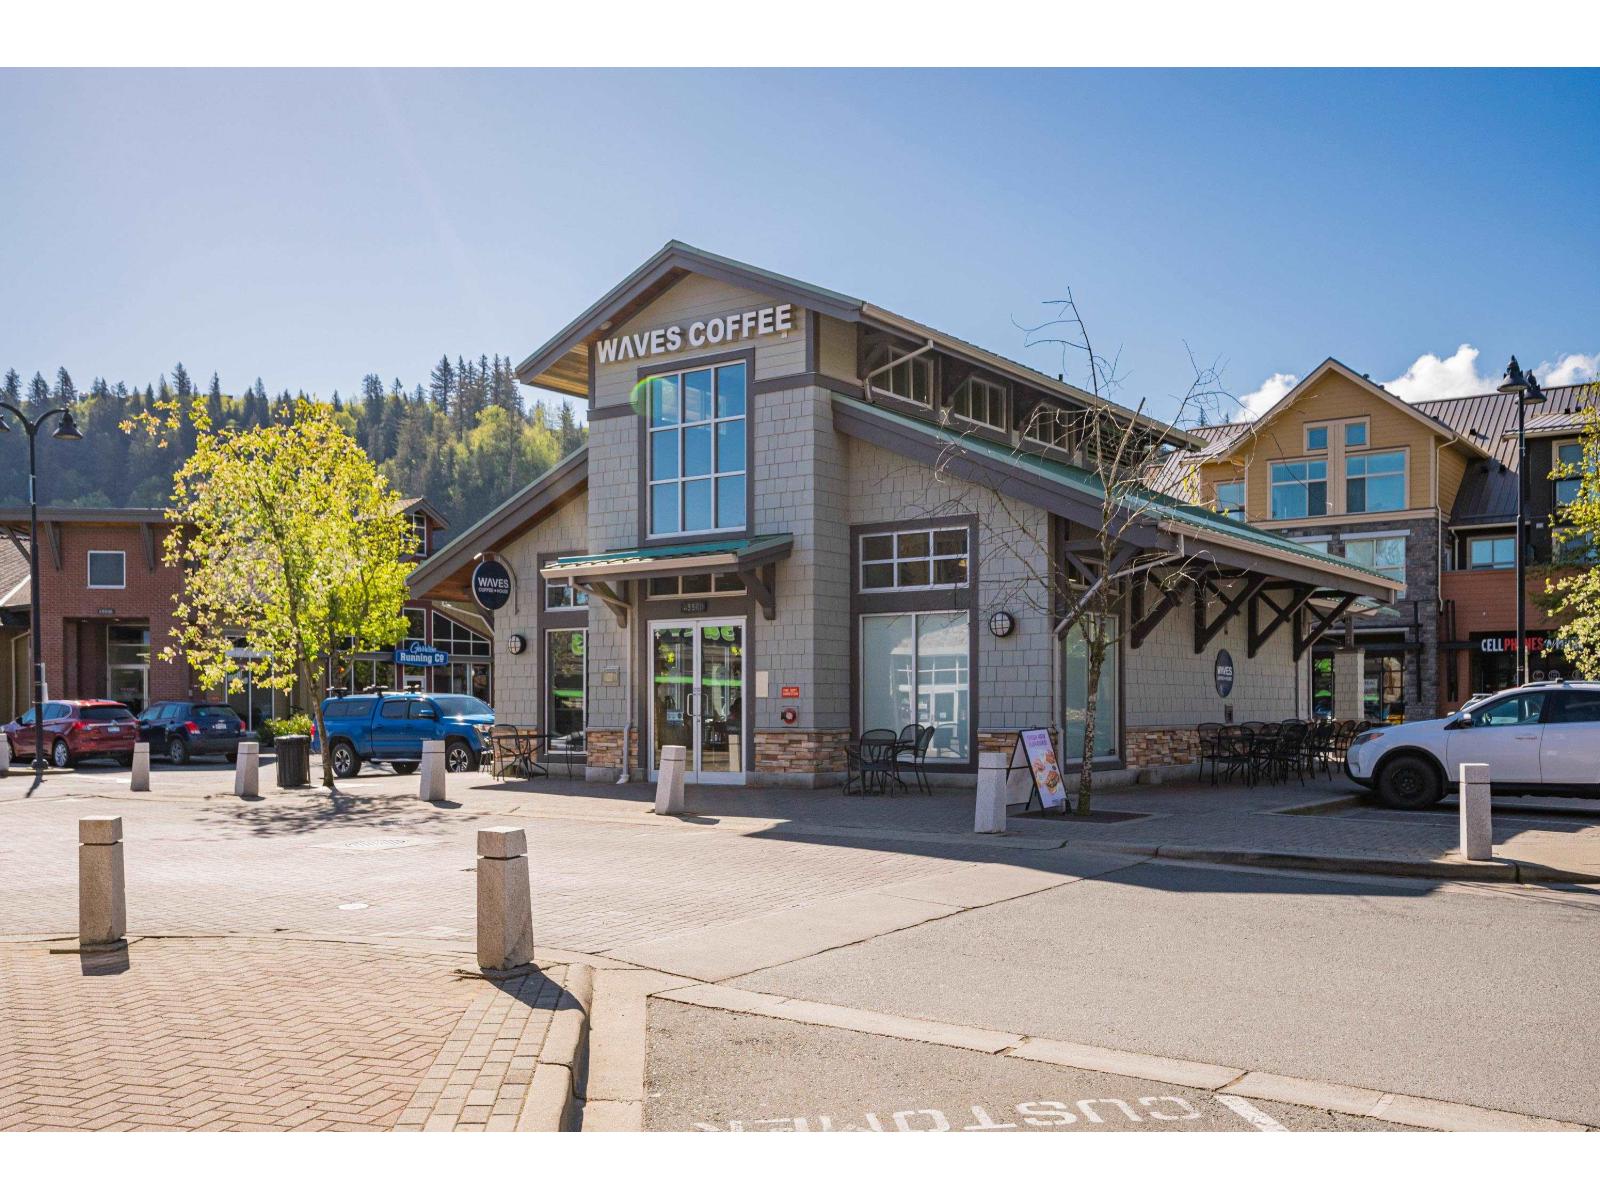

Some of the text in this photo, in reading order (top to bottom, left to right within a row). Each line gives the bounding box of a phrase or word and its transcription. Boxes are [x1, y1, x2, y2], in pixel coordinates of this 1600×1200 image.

[597, 304, 791, 363] WAVES COFFEE
[478, 577, 509, 588] WAVES
[400, 653, 432, 664] Running
